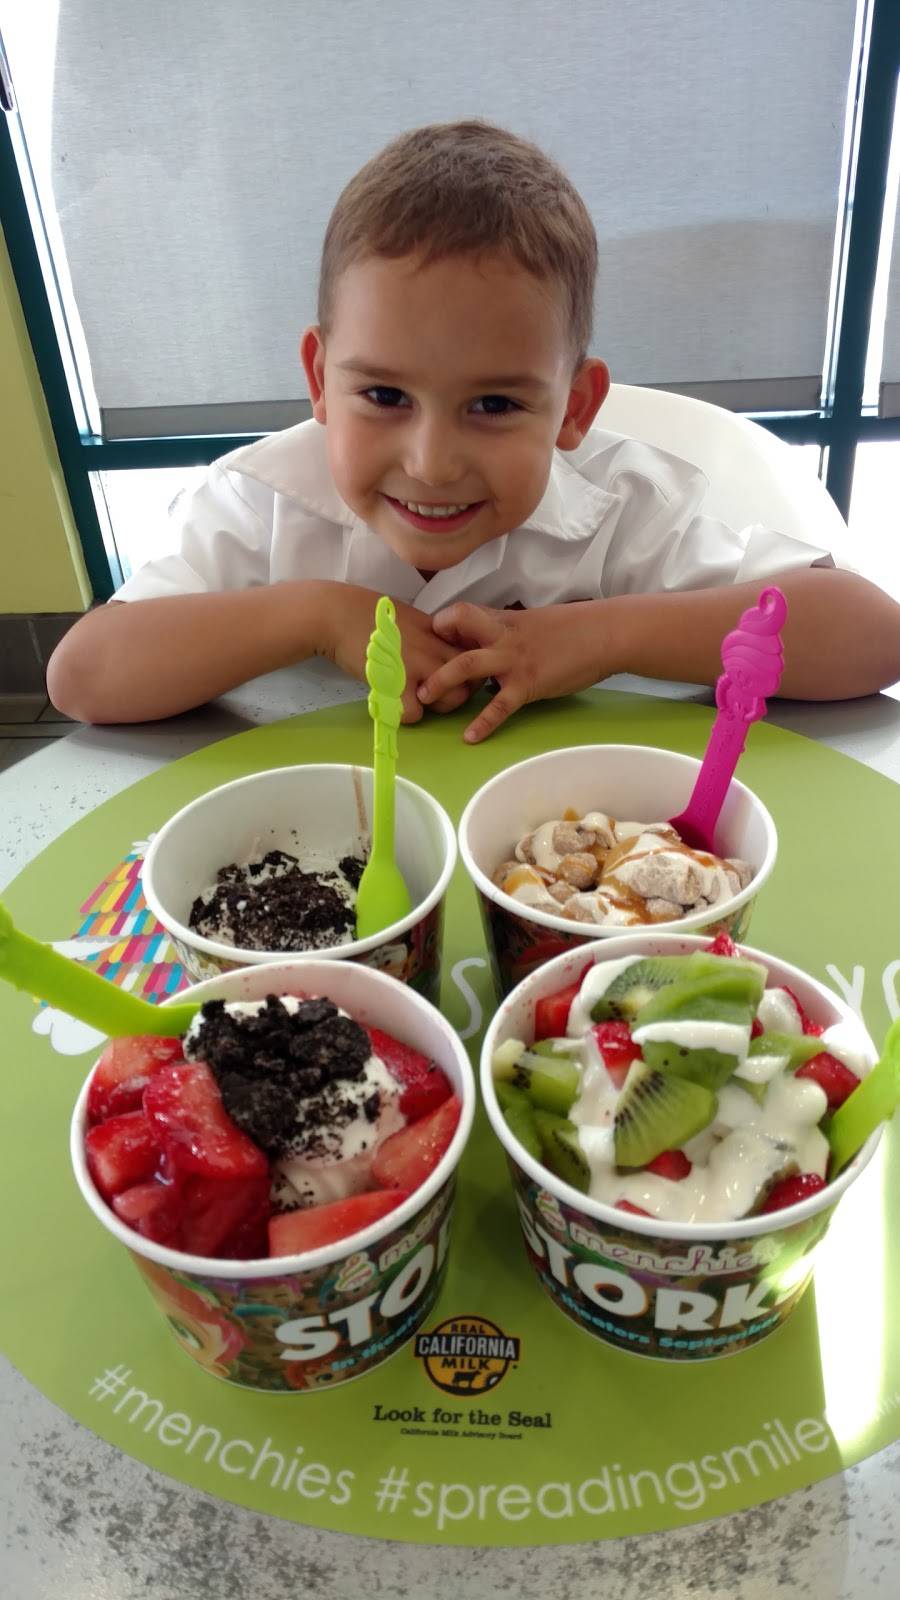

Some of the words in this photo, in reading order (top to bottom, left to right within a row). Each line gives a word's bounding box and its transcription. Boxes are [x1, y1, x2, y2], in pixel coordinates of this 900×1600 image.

[450, 1323, 486, 1335] REAL
[560, 1293, 650, 1344] theaters
[658, 1310, 783, 1350] September
[417, 1335, 517, 1359] CALIFORNIA
[440, 1357, 491, 1371] MILK
[373, 1405, 427, 1423] Look
[432, 1408, 464, 1425] for
[468, 1410, 502, 1426] the
[508, 1411, 553, 1429] Seal
[87, 1363, 356, 1505] #menchies
[375, 1414, 830, 1531] #spreadingsmile
